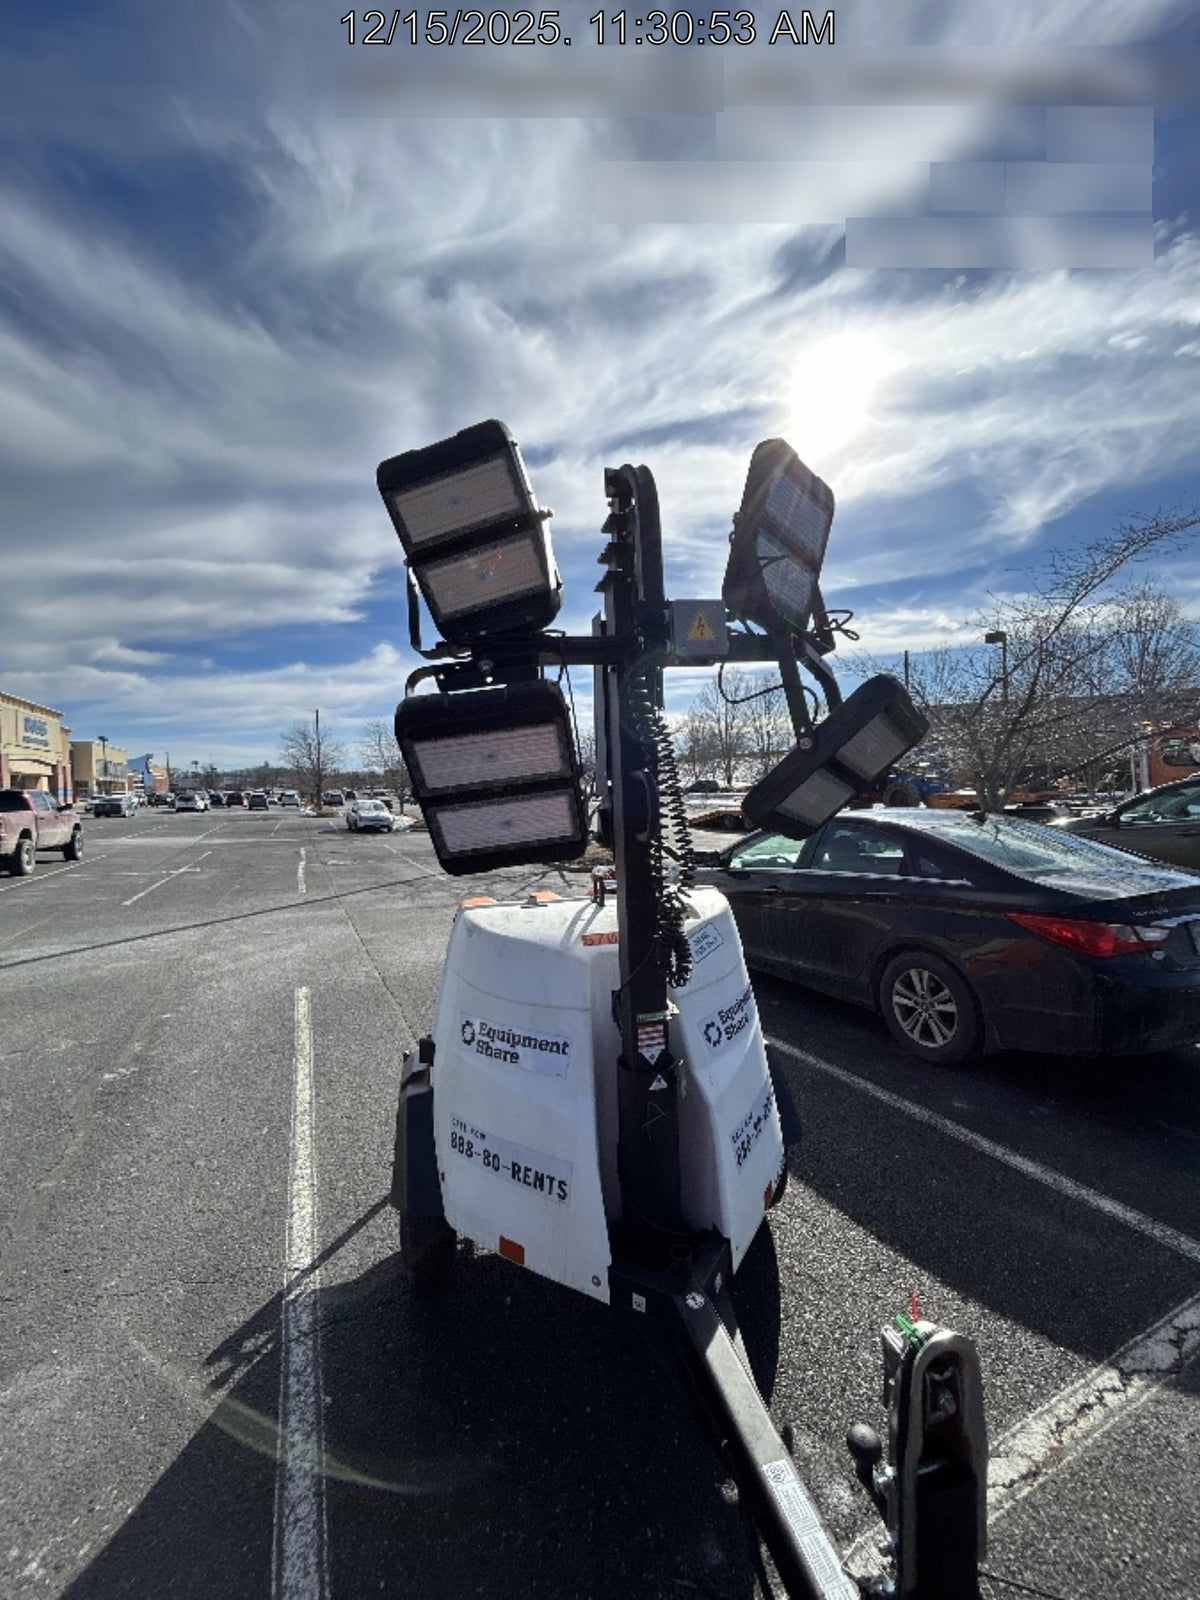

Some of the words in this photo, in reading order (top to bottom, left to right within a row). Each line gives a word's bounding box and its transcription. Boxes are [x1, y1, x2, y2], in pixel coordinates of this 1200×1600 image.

[476, 1039, 520, 1064] Share
[478, 1021, 570, 1055] Equipment
[451, 1131, 568, 1201] 888-80-RENTS
